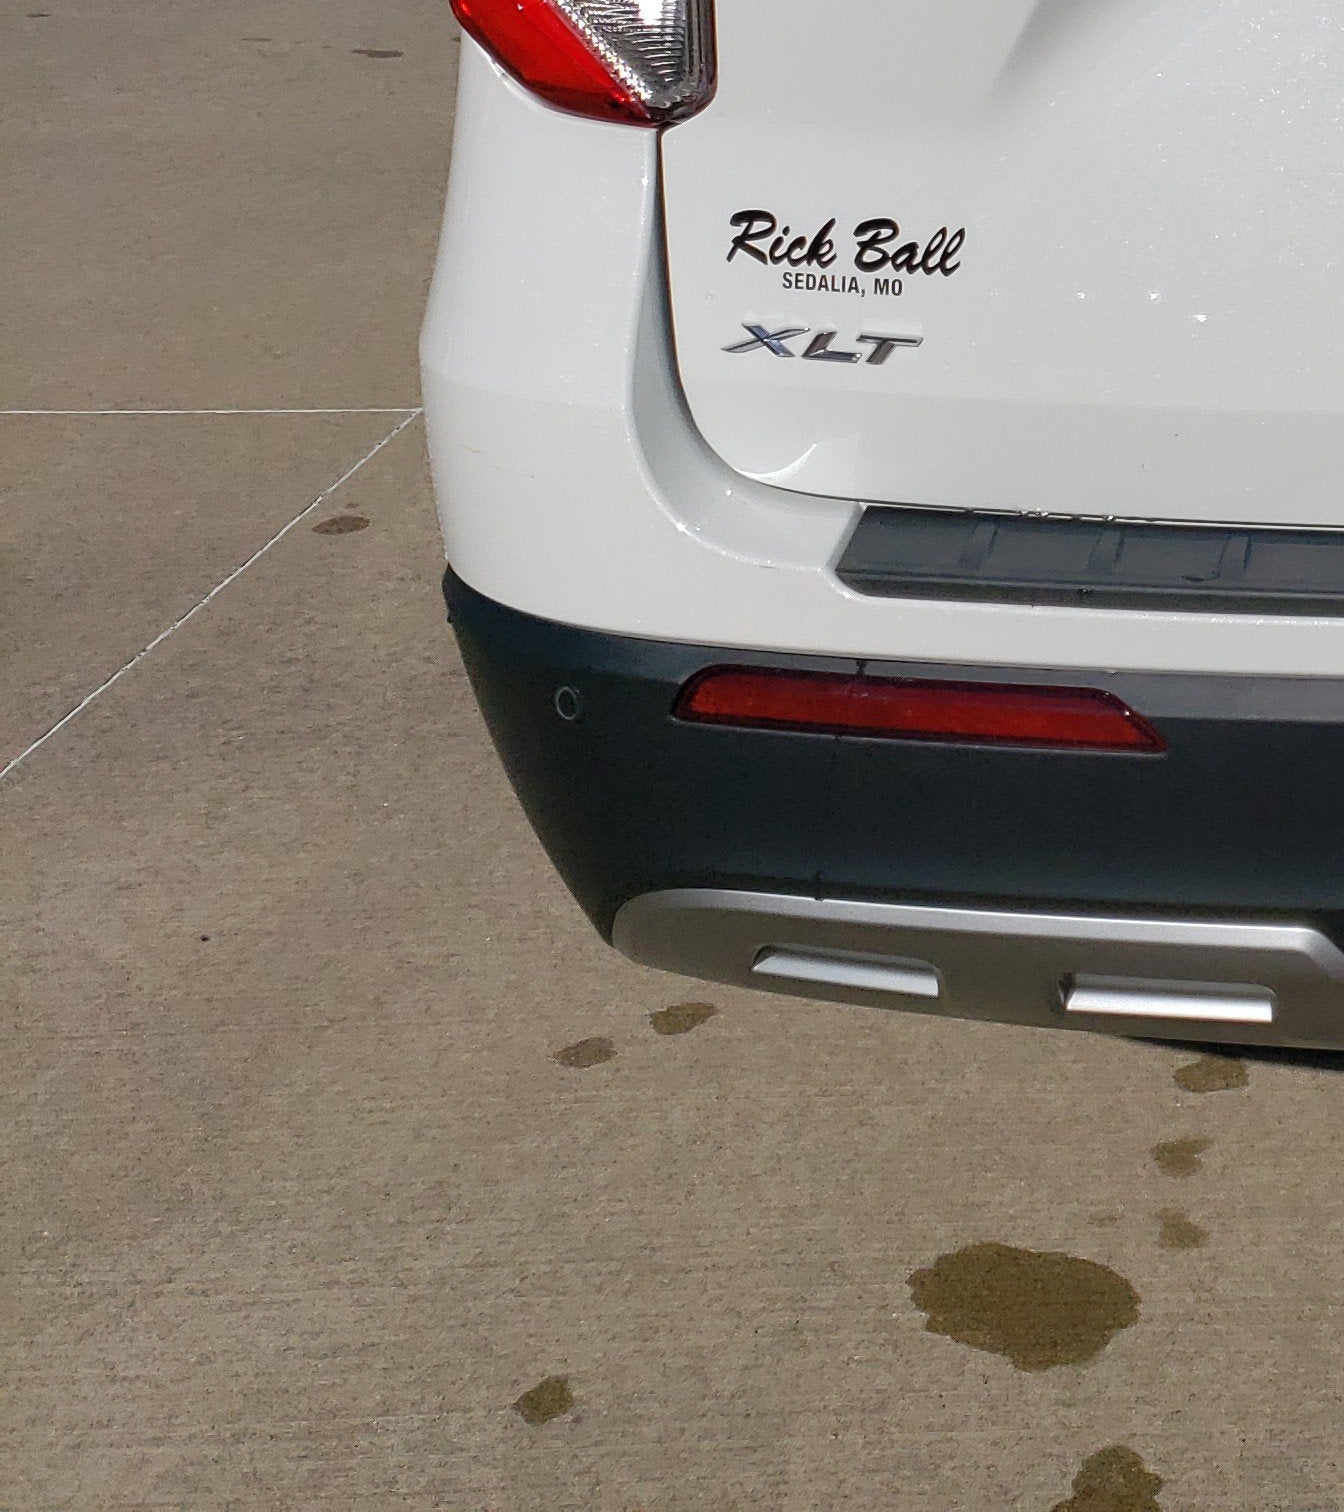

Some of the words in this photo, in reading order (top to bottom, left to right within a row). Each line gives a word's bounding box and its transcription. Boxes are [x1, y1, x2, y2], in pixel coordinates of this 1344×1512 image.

[726, 209, 837, 269] Rick
[853, 217, 966, 277] Ball
[782, 271, 866, 298] SEDALIA,
[874, 277, 903, 297] MO
[721, 322, 924, 365] XLT
